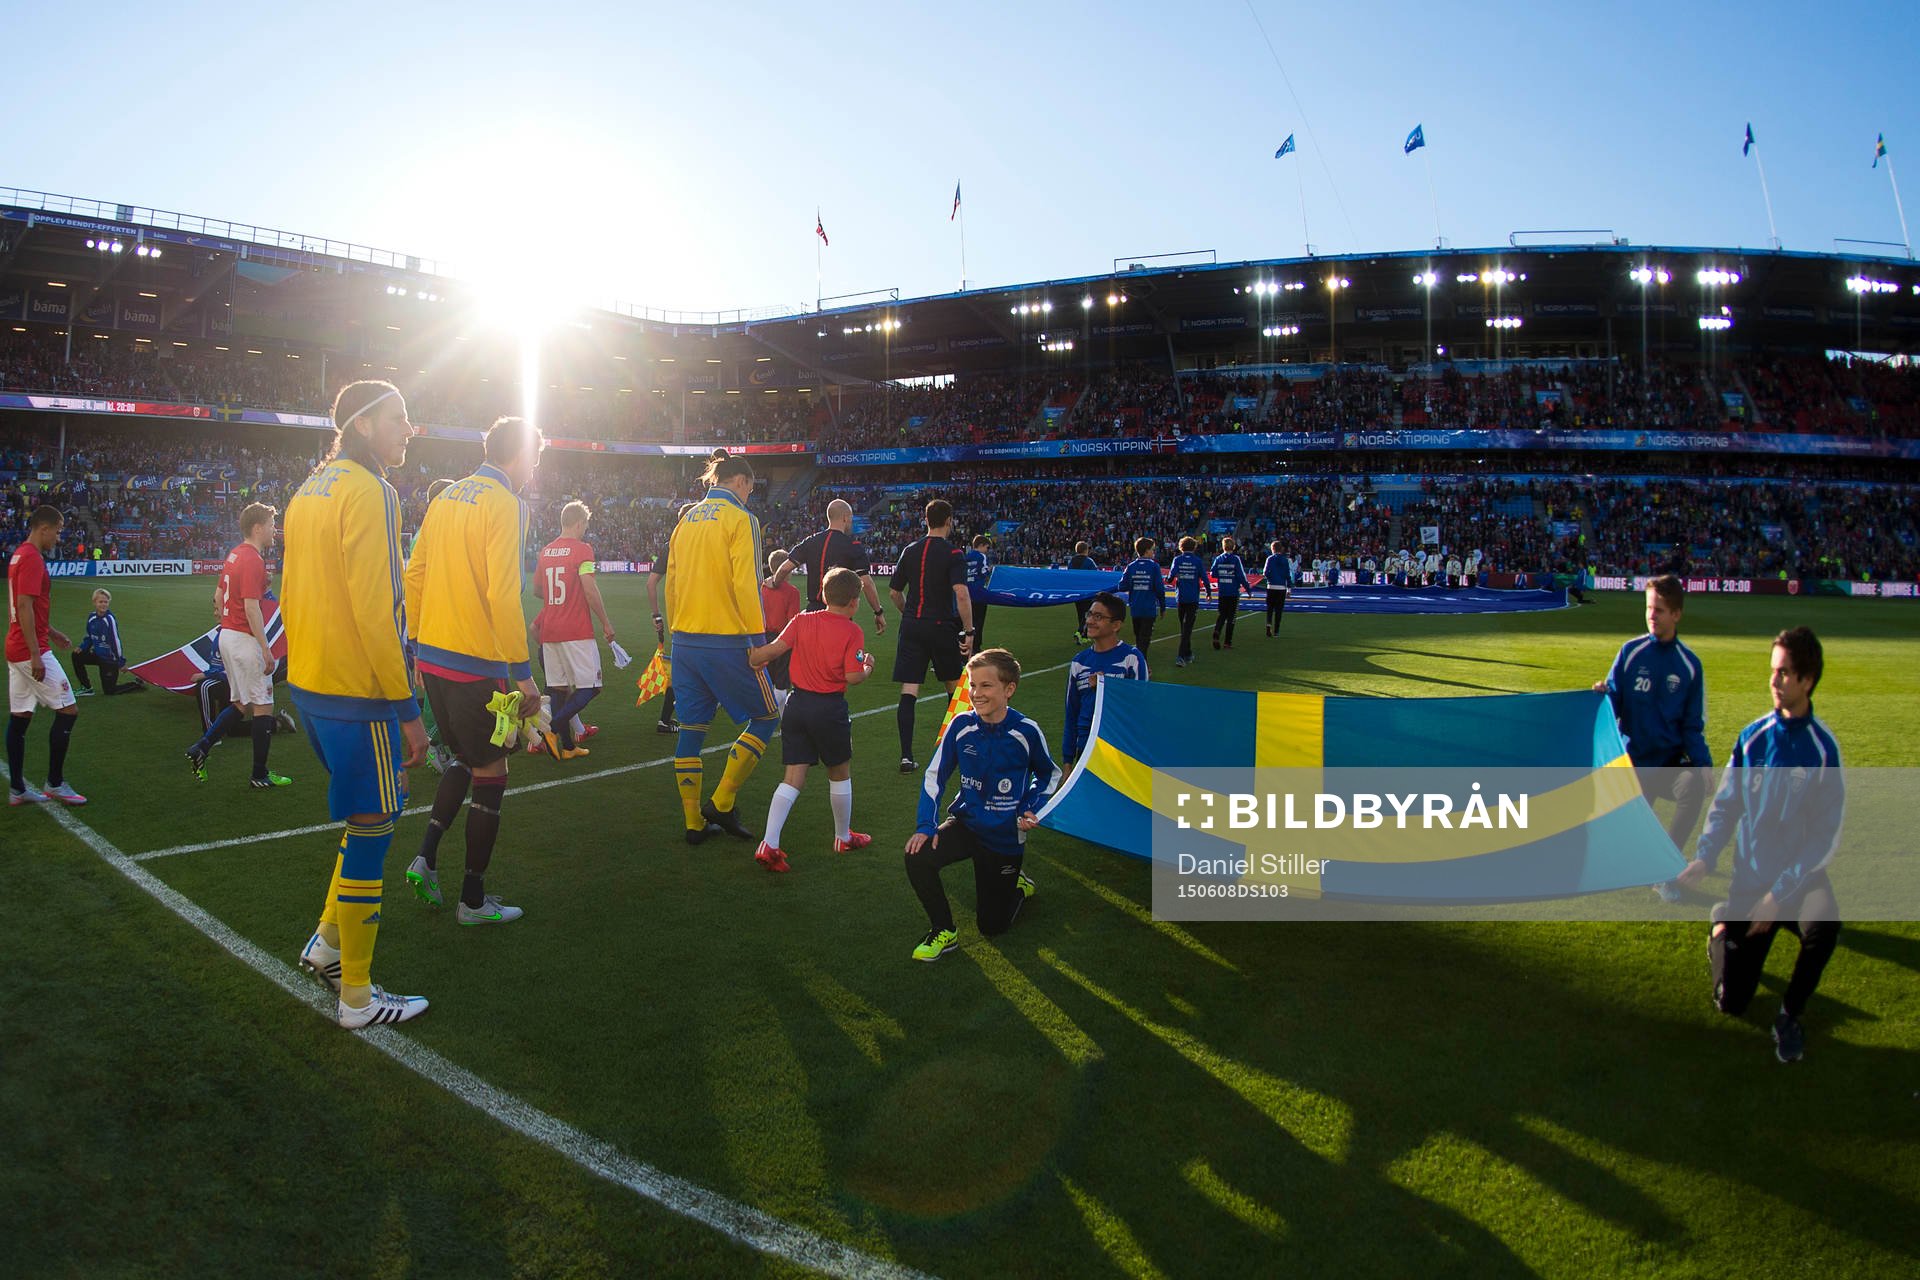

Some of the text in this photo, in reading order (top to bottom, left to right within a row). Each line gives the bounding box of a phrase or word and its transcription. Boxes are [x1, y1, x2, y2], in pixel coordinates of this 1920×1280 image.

[34, 215, 136, 235] OPPLEV BENDIT-EFFEKTEN
[33, 300, 66, 314] bama
[125, 309, 156, 323] bama
[1360, 434, 1450, 445] NORSK TIPPING
[1648, 436, 1729, 448] NORSK TIPPING
[1072, 443, 1112, 453] NORSK
[827, 452, 896, 464] NORSK TIPPING
[134, 475, 157, 489] Bendit
[46, 562, 88, 576] MAPEI
[113, 563, 185, 574] UNIVERN
[600, 561, 628, 573] SVERIGE
[638, 562, 650, 573] juni
[546, 566, 566, 605] 15
[1594, 577, 1627, 590] NORGE
[1687, 578, 1751, 593] juni kl. 20:00
[1852, 582, 1877, 596] NORGE
[1881, 582, 1912, 596] SVERIGE
[1634, 676, 1652, 692] 20
[960, 774, 982, 791] bring
